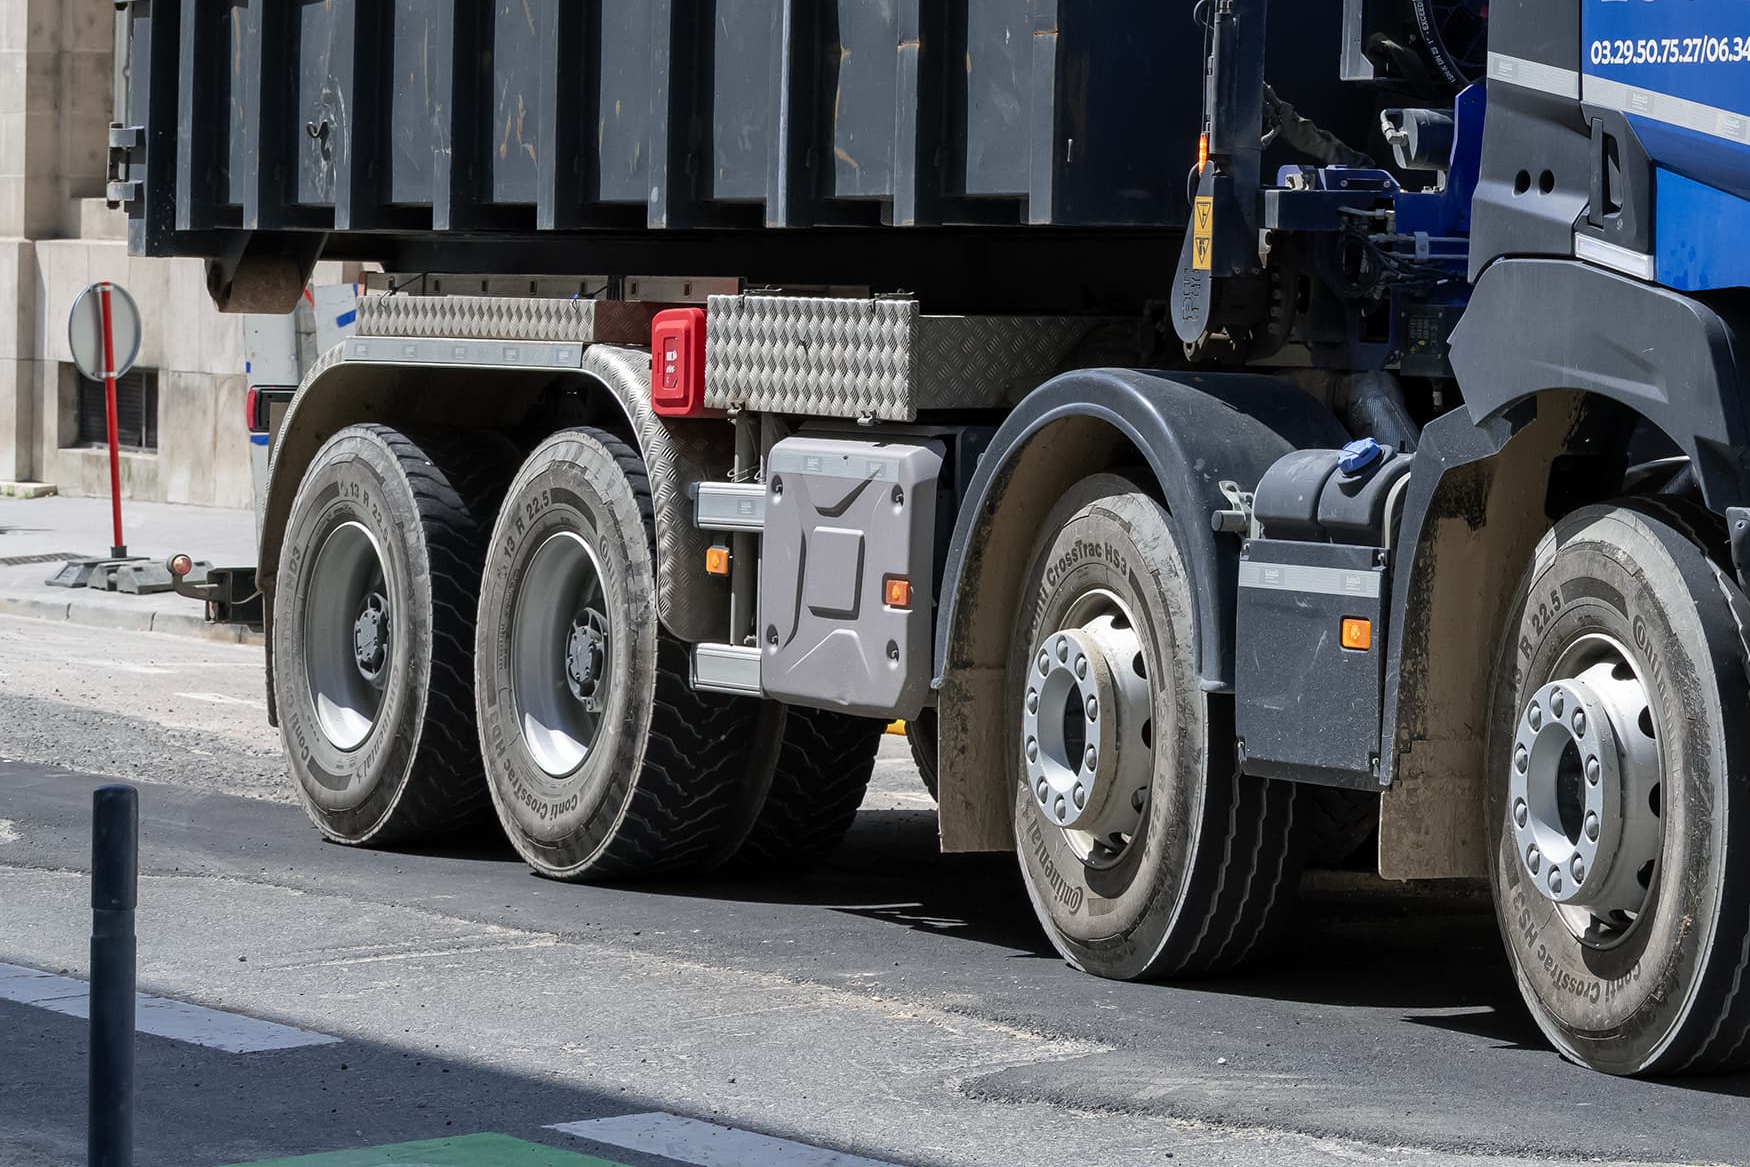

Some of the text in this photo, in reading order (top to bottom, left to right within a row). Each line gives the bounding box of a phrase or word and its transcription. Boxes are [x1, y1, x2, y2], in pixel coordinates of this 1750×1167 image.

[504, 490, 550, 558] 13 R 22.5
[1046, 539, 1103, 587] CrossTrac
[1103, 542, 1128, 576] HS3
[1519, 635, 1534, 661] R
[1531, 589, 1562, 636] 22.5
[503, 758, 548, 820] CrossTrac
[549, 793, 578, 821] Conti
[1026, 820, 1084, 915] Continental
[1513, 892, 1642, 1004] Conti CrossTrac HS3
